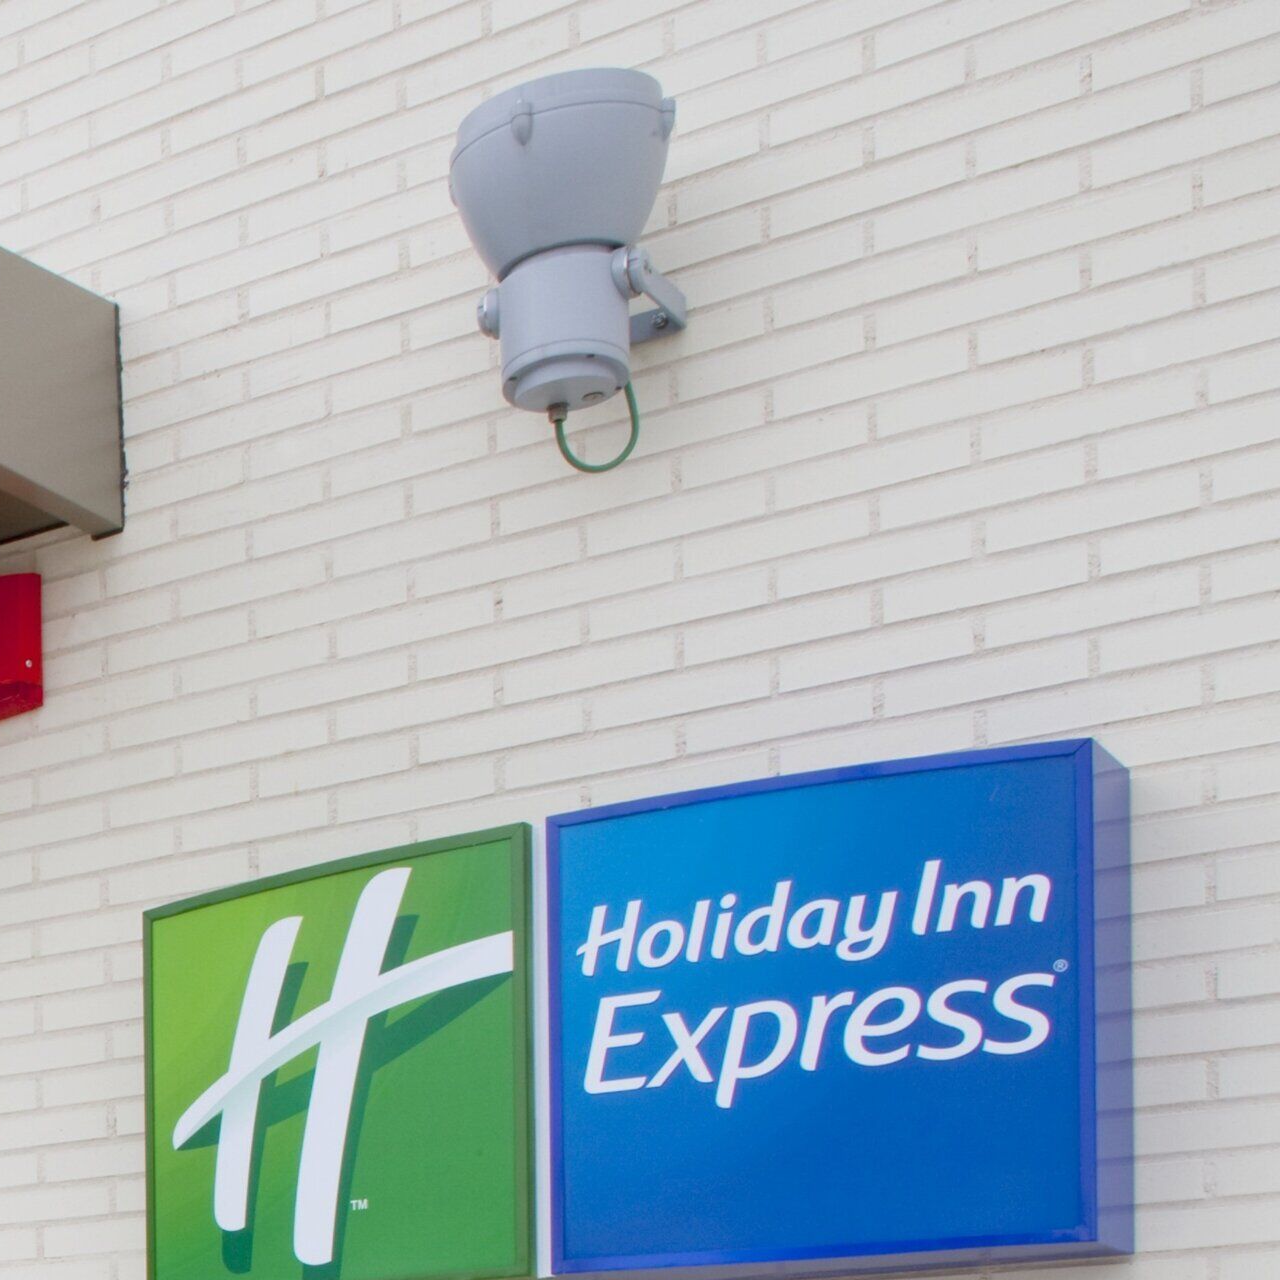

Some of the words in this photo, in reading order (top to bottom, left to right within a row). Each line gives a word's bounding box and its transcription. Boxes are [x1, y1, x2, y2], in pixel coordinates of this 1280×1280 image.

[575, 879, 898, 978] Holiday
[913, 859, 1052, 934] Inn
[582, 971, 1055, 1110] Express
